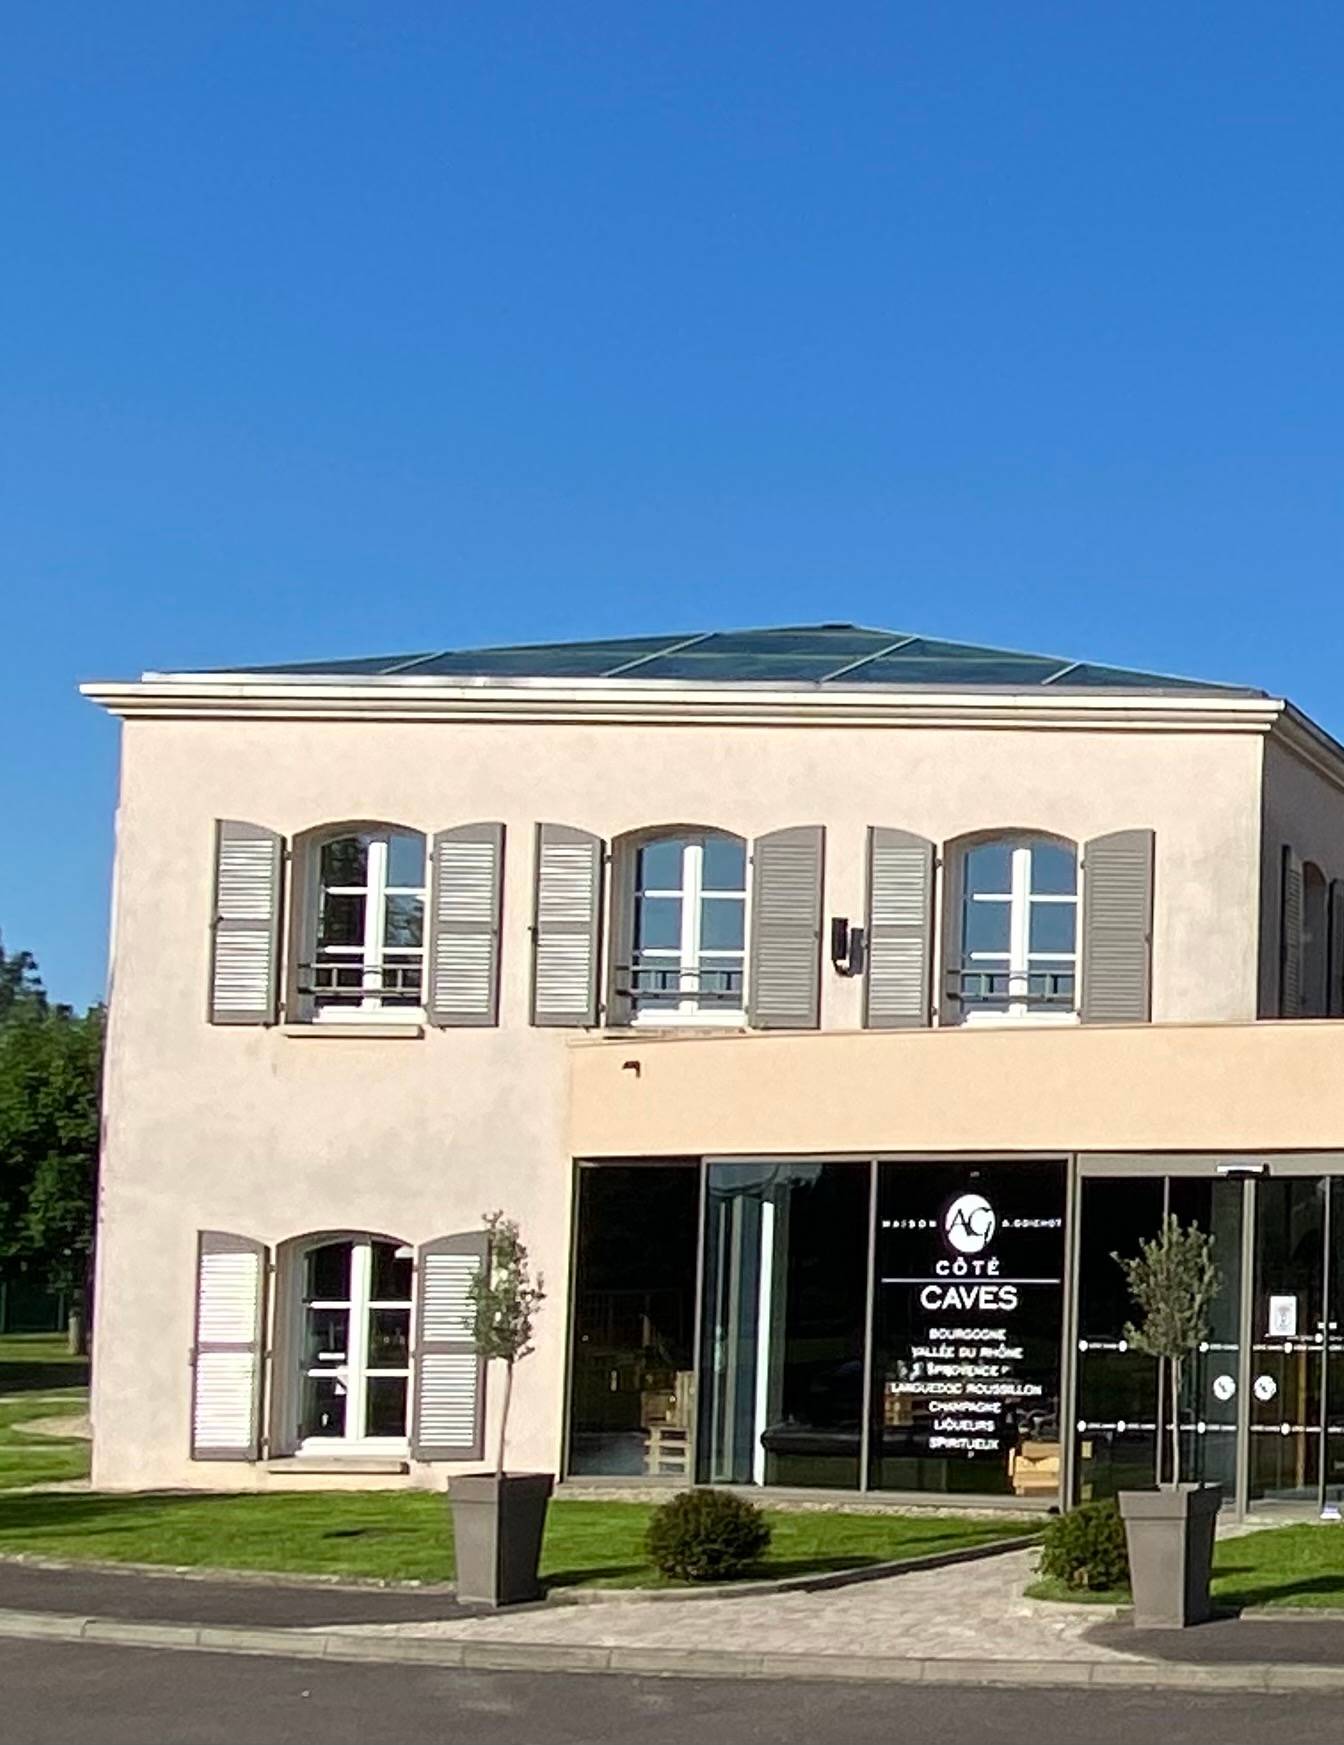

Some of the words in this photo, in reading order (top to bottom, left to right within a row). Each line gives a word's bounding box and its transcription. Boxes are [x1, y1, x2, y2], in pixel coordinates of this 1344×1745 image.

[936, 1257, 999, 1275] CÔTÉ
[921, 1285, 1017, 1310] CAVES
[959, 1347, 976, 1358] DU
